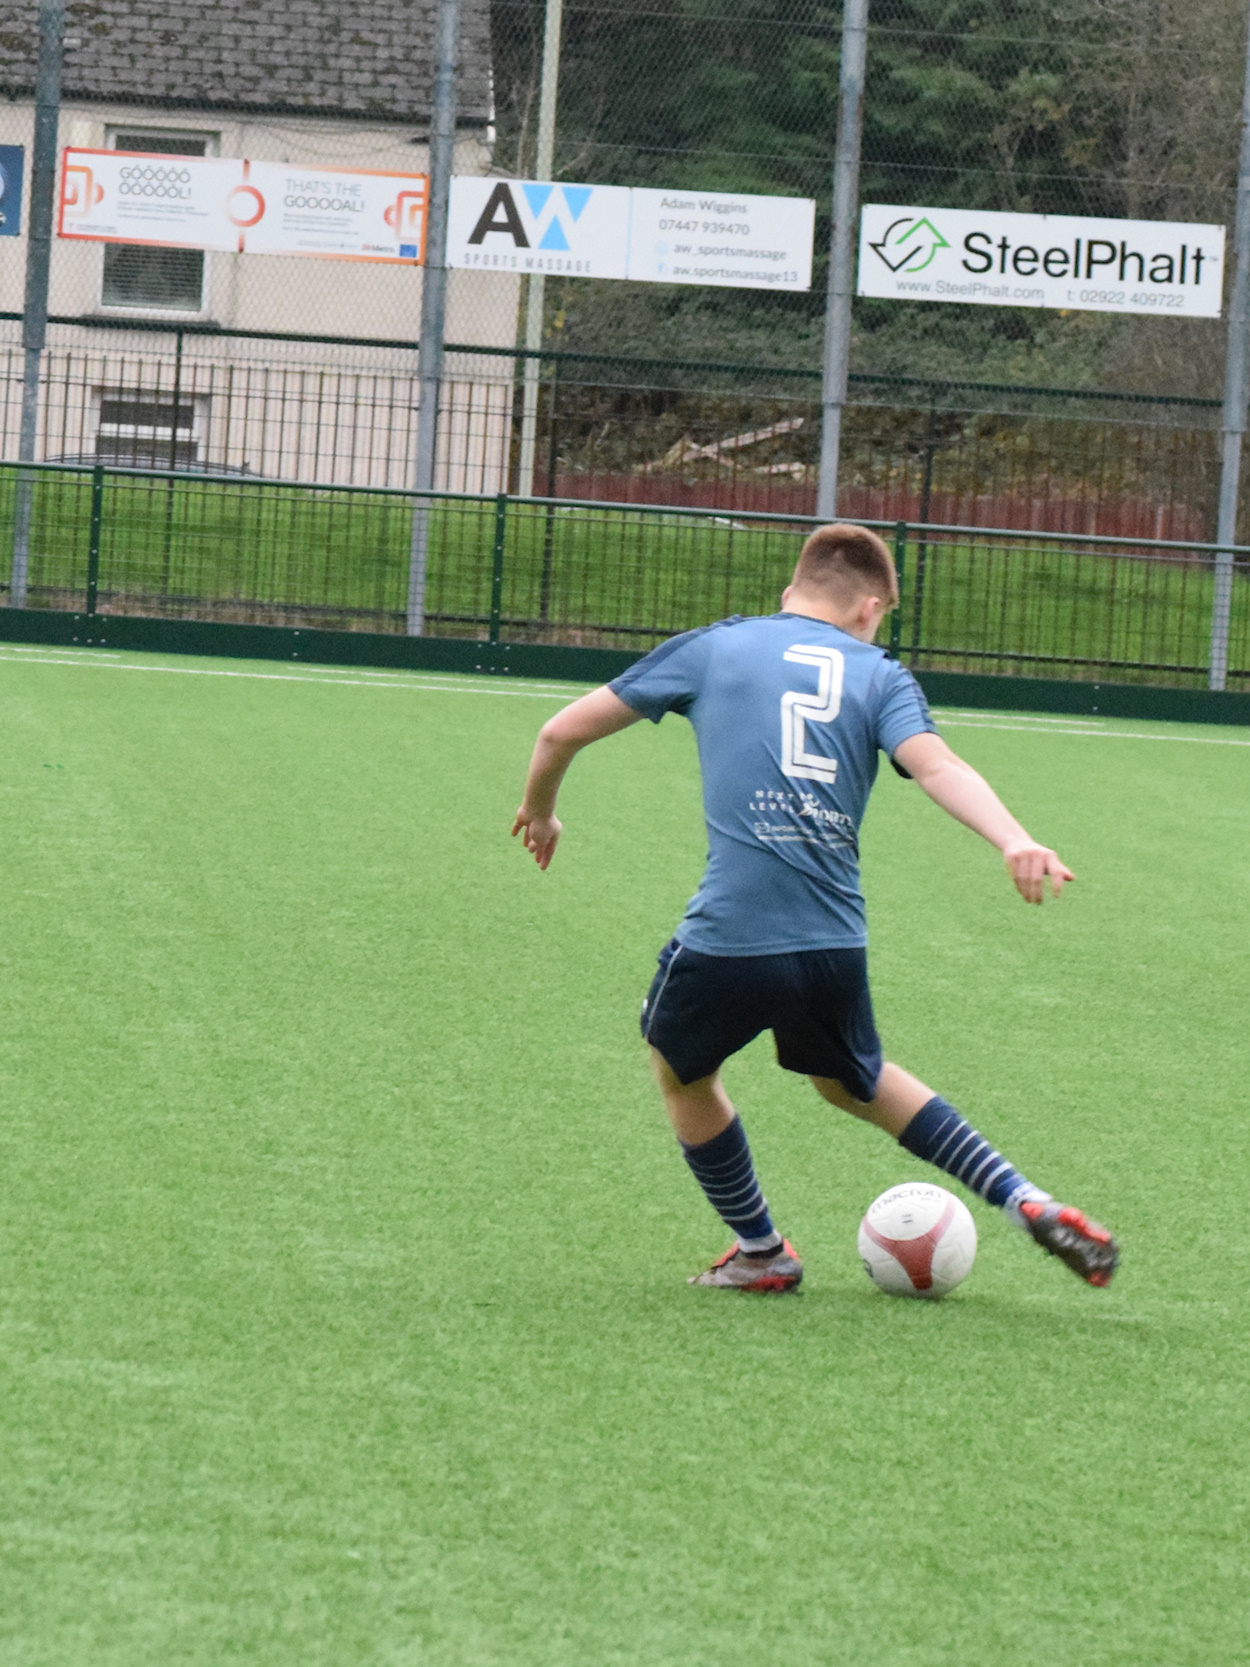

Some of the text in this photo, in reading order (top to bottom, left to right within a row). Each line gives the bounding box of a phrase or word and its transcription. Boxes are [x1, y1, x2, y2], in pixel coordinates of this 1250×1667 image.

[335, 182, 362, 198] THE
[660, 197, 748, 215] Adam Wiggins
[659, 218, 751, 236] 07447 939470
[464, 252, 593, 273] SPORTS MASSAGE
[961, 231, 1206, 285] SteelPhalt
[895, 279, 1045, 300] www.SteelPhalt.com
[1079, 288, 1126, 304] 02922
[1129, 291, 1185, 308] 409722
[780, 643, 845, 785] 2
[871, 1188, 942, 1214] macron
